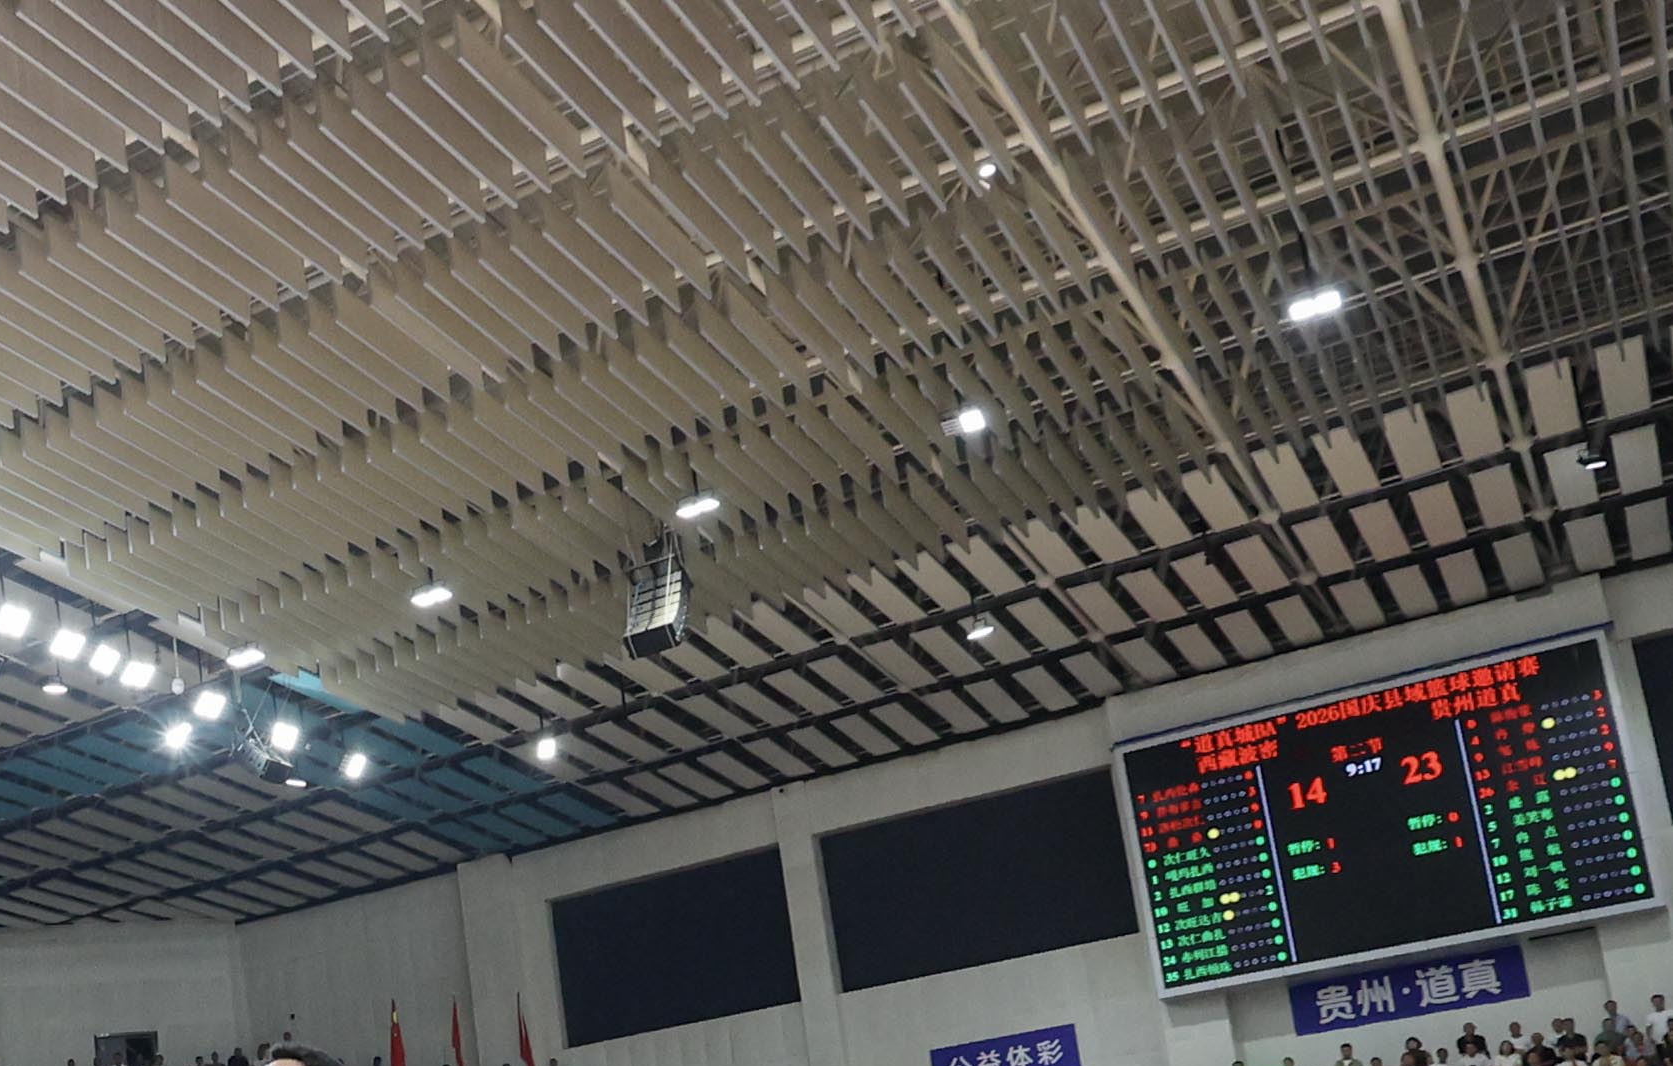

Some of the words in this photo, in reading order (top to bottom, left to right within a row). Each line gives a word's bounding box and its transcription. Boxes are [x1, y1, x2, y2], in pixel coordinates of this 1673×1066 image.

[1431, 682, 1522, 720] 贵州道真
[1345, 757, 1383, 776] 9:17
[1400, 751, 1444, 785] 23
[1288, 776, 1327, 810] 14
[1485, 805, 1493, 815] 2
[1488, 821, 1497, 832] 5
[1491, 838, 1499, 848] 7
[1492, 855, 1508, 866] 10
[1496, 872, 1511, 884] 12
[1154, 891, 1162, 901] 2
[1500, 890, 1514, 901] 17
[1155, 907, 1168, 917] 10
[1158, 923, 1171, 933] 12
[1161, 939, 1173, 950] 13
[1316, 958, 1502, 1024] 贵州·道真
